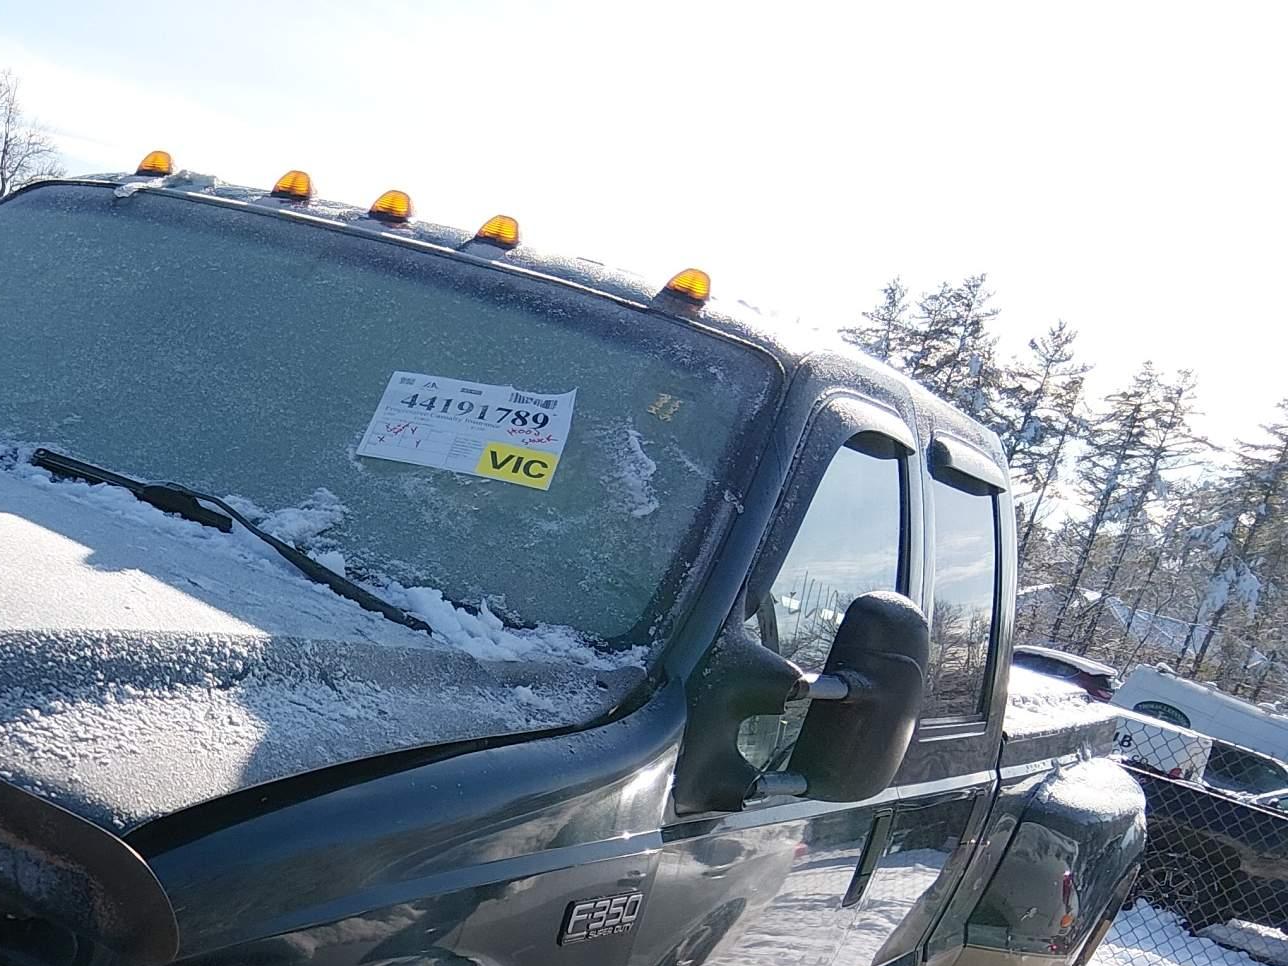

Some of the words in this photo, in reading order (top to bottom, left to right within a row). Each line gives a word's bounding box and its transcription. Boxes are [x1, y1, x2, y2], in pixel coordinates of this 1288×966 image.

[400, 393, 550, 431] 44191789
[490, 450, 549, 479] VIC
[587, 927, 613, 940] SUPER
[613, 922, 634, 935] DUTY
